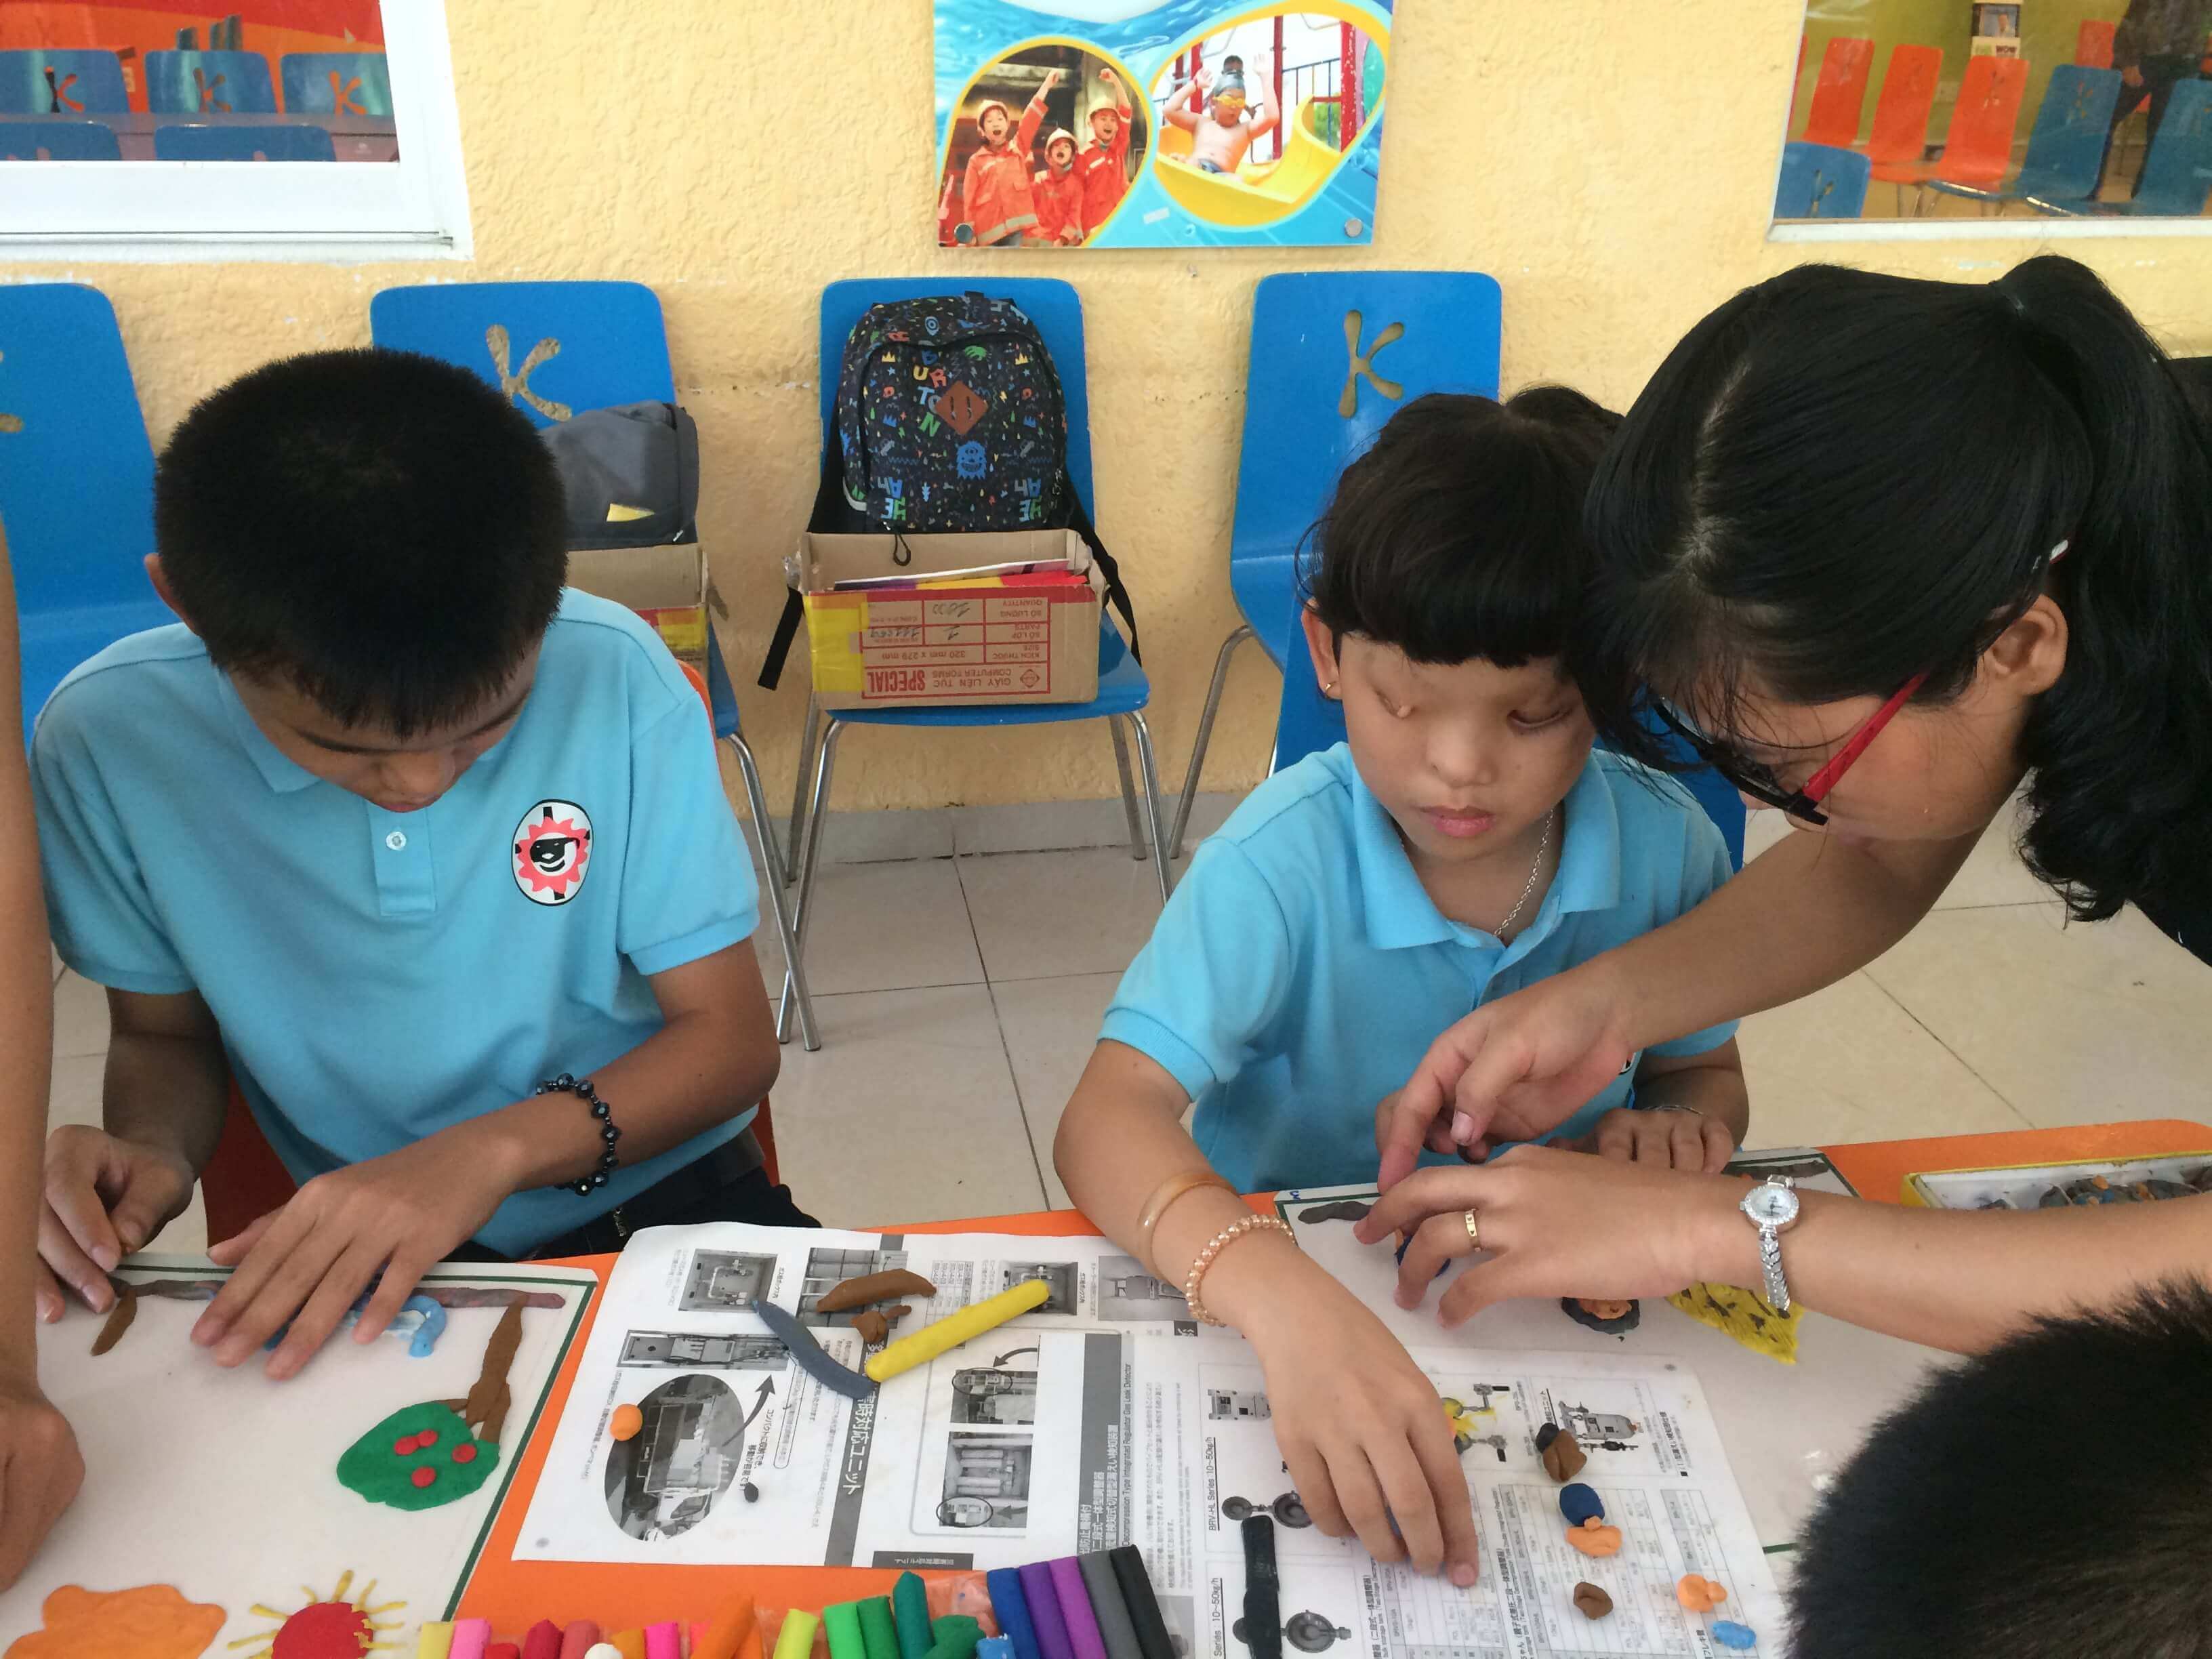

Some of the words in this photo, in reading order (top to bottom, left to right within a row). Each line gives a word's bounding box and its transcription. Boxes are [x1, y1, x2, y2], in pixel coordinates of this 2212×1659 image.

[949, 651, 965, 659] 320
[867, 670, 926, 693] SPECIAL
[964, 668, 1012, 677] COMPUTER
[1123, 1364, 1131, 1388] Detector
[1123, 1389, 1131, 1403] Leak
[1123, 1416, 1133, 1445] Regulator
[1122, 1445, 1132, 1478] Integrated
[1122, 1479, 1132, 1495] Type
[1207, 1478, 1215, 1500] Series
[1214, 1630, 1223, 1658] Series
